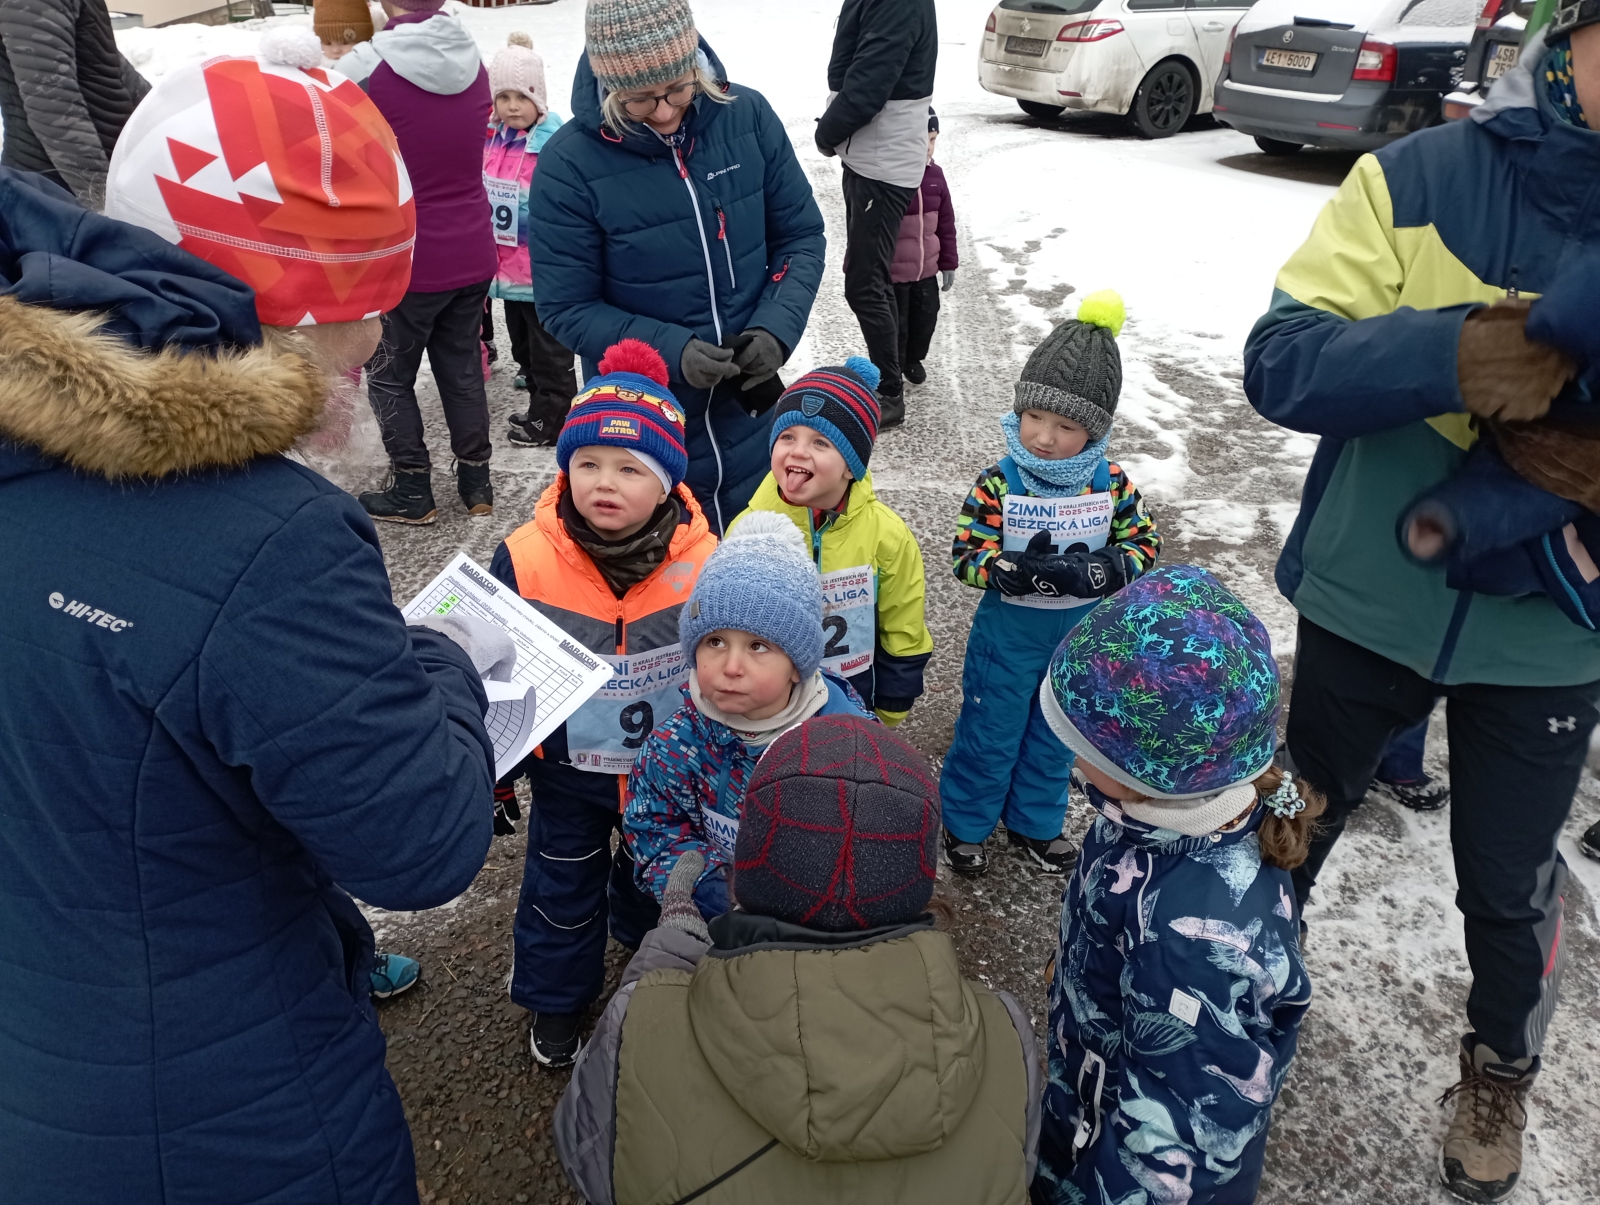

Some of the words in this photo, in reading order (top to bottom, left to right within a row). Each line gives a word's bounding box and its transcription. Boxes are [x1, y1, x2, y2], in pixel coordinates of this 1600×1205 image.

[1265, 52, 1282, 64] 4E1
[1287, 55, 1311, 69] 5000
[497, 191, 517, 200] LIGA
[611, 419, 630, 427] PAW
[602, 426, 638, 437] PATROL
[1007, 502, 1057, 518] ZIMNÍ
[1058, 504, 1110, 517] 2025-2026
[1007, 517, 1079, 531] BĚŽECKÁ
[1081, 515, 1109, 529] LIGA
[822, 577, 868, 591] 25-2026
[834, 587, 869, 603] LIGA
[63, 600, 128, 633] HI-TEC
[459, 562, 500, 594] MARATON
[559, 639, 600, 670] MARATON
[821, 615, 850, 659] 2
[609, 660, 630, 676] NÍ
[637, 657, 654, 666] KRÁLE
[632, 655, 684, 674] 2025-20
[841, 654, 870, 668] MARATON
[600, 672, 654, 690] ECKÁ
[658, 662, 692, 681] LIGA
[619, 700, 654, 749] 9
[702, 811, 737, 839] ZIMN
